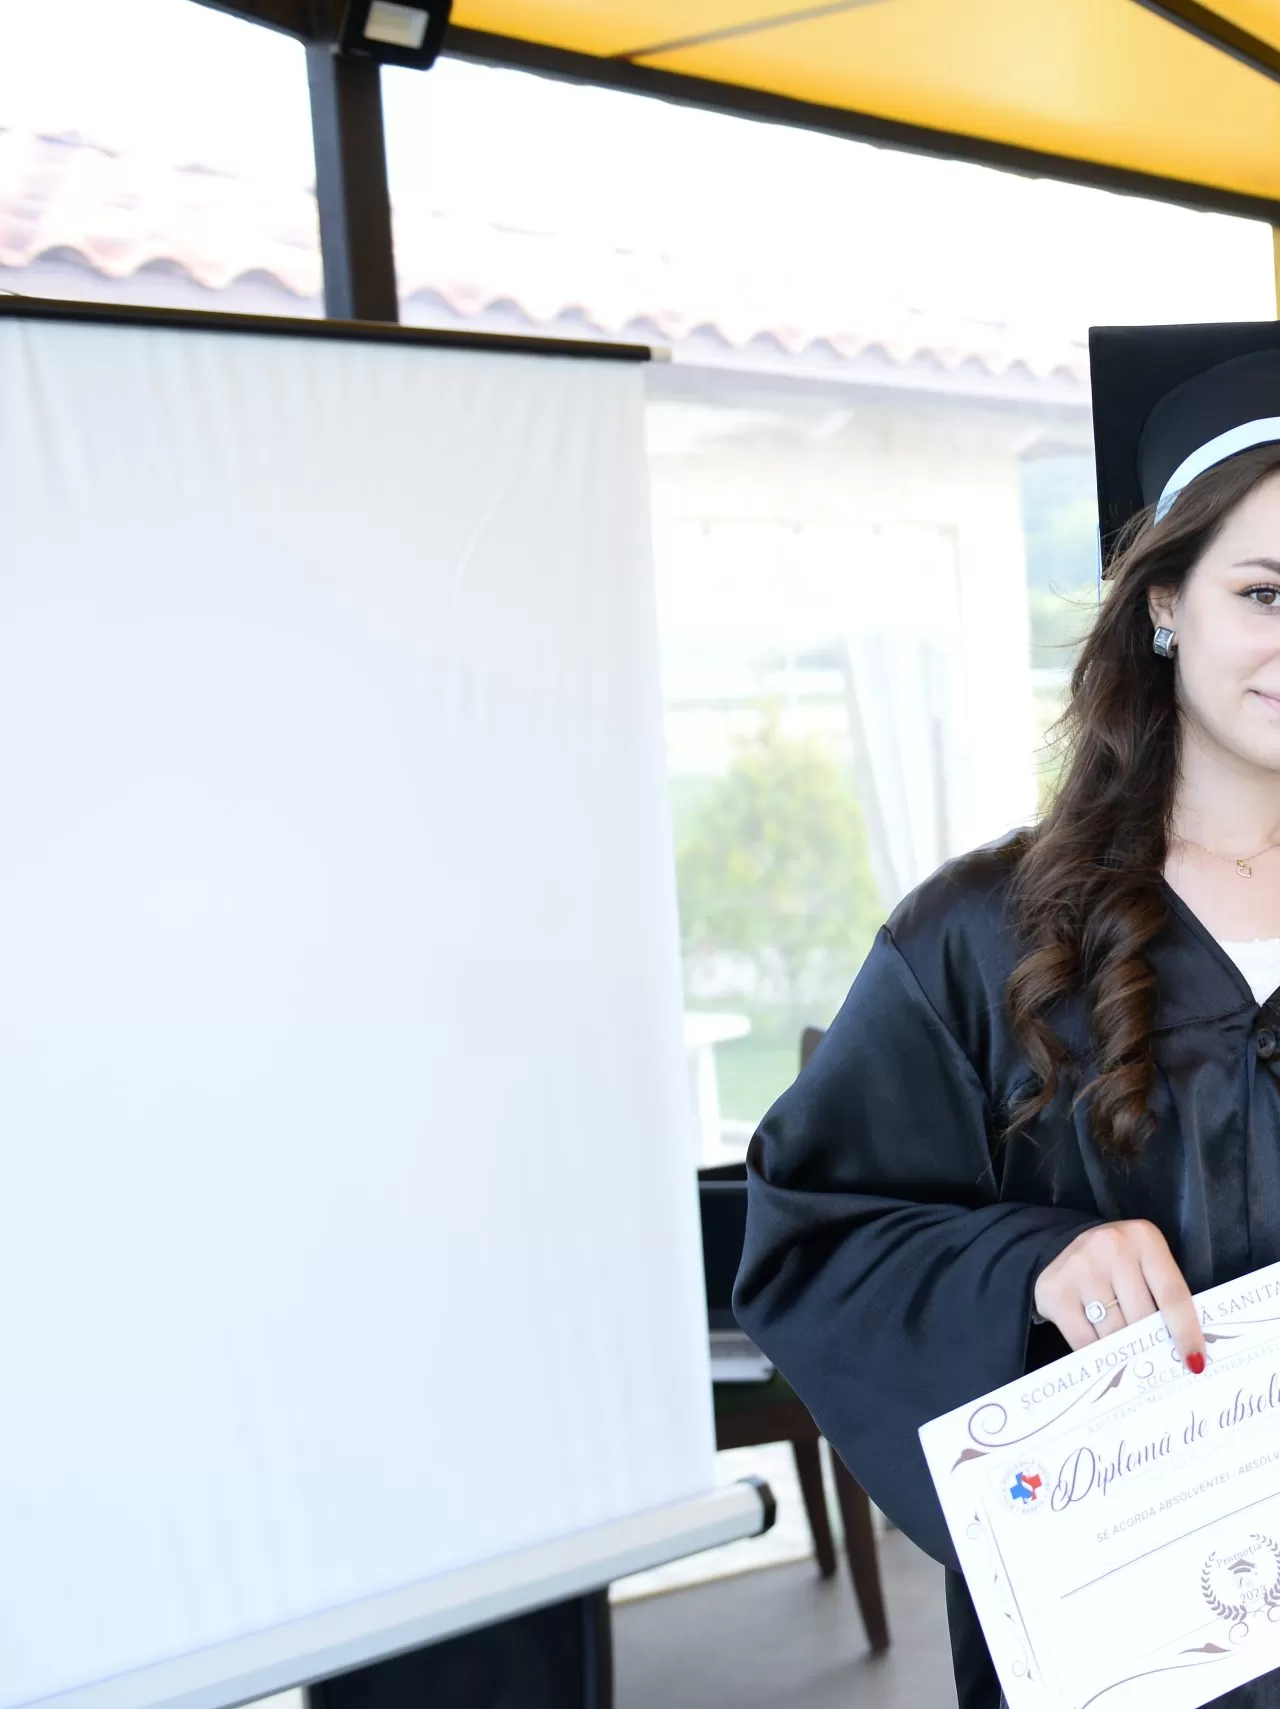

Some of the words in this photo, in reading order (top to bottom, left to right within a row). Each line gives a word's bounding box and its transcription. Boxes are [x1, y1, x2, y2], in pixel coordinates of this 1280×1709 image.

[1183, 1410, 1209, 1445] de
[1096, 1528, 1110, 1544] SE
[1159, 1470, 1232, 1513] ABSOLVENTEI
[1240, 1584, 1267, 1604] 2023
